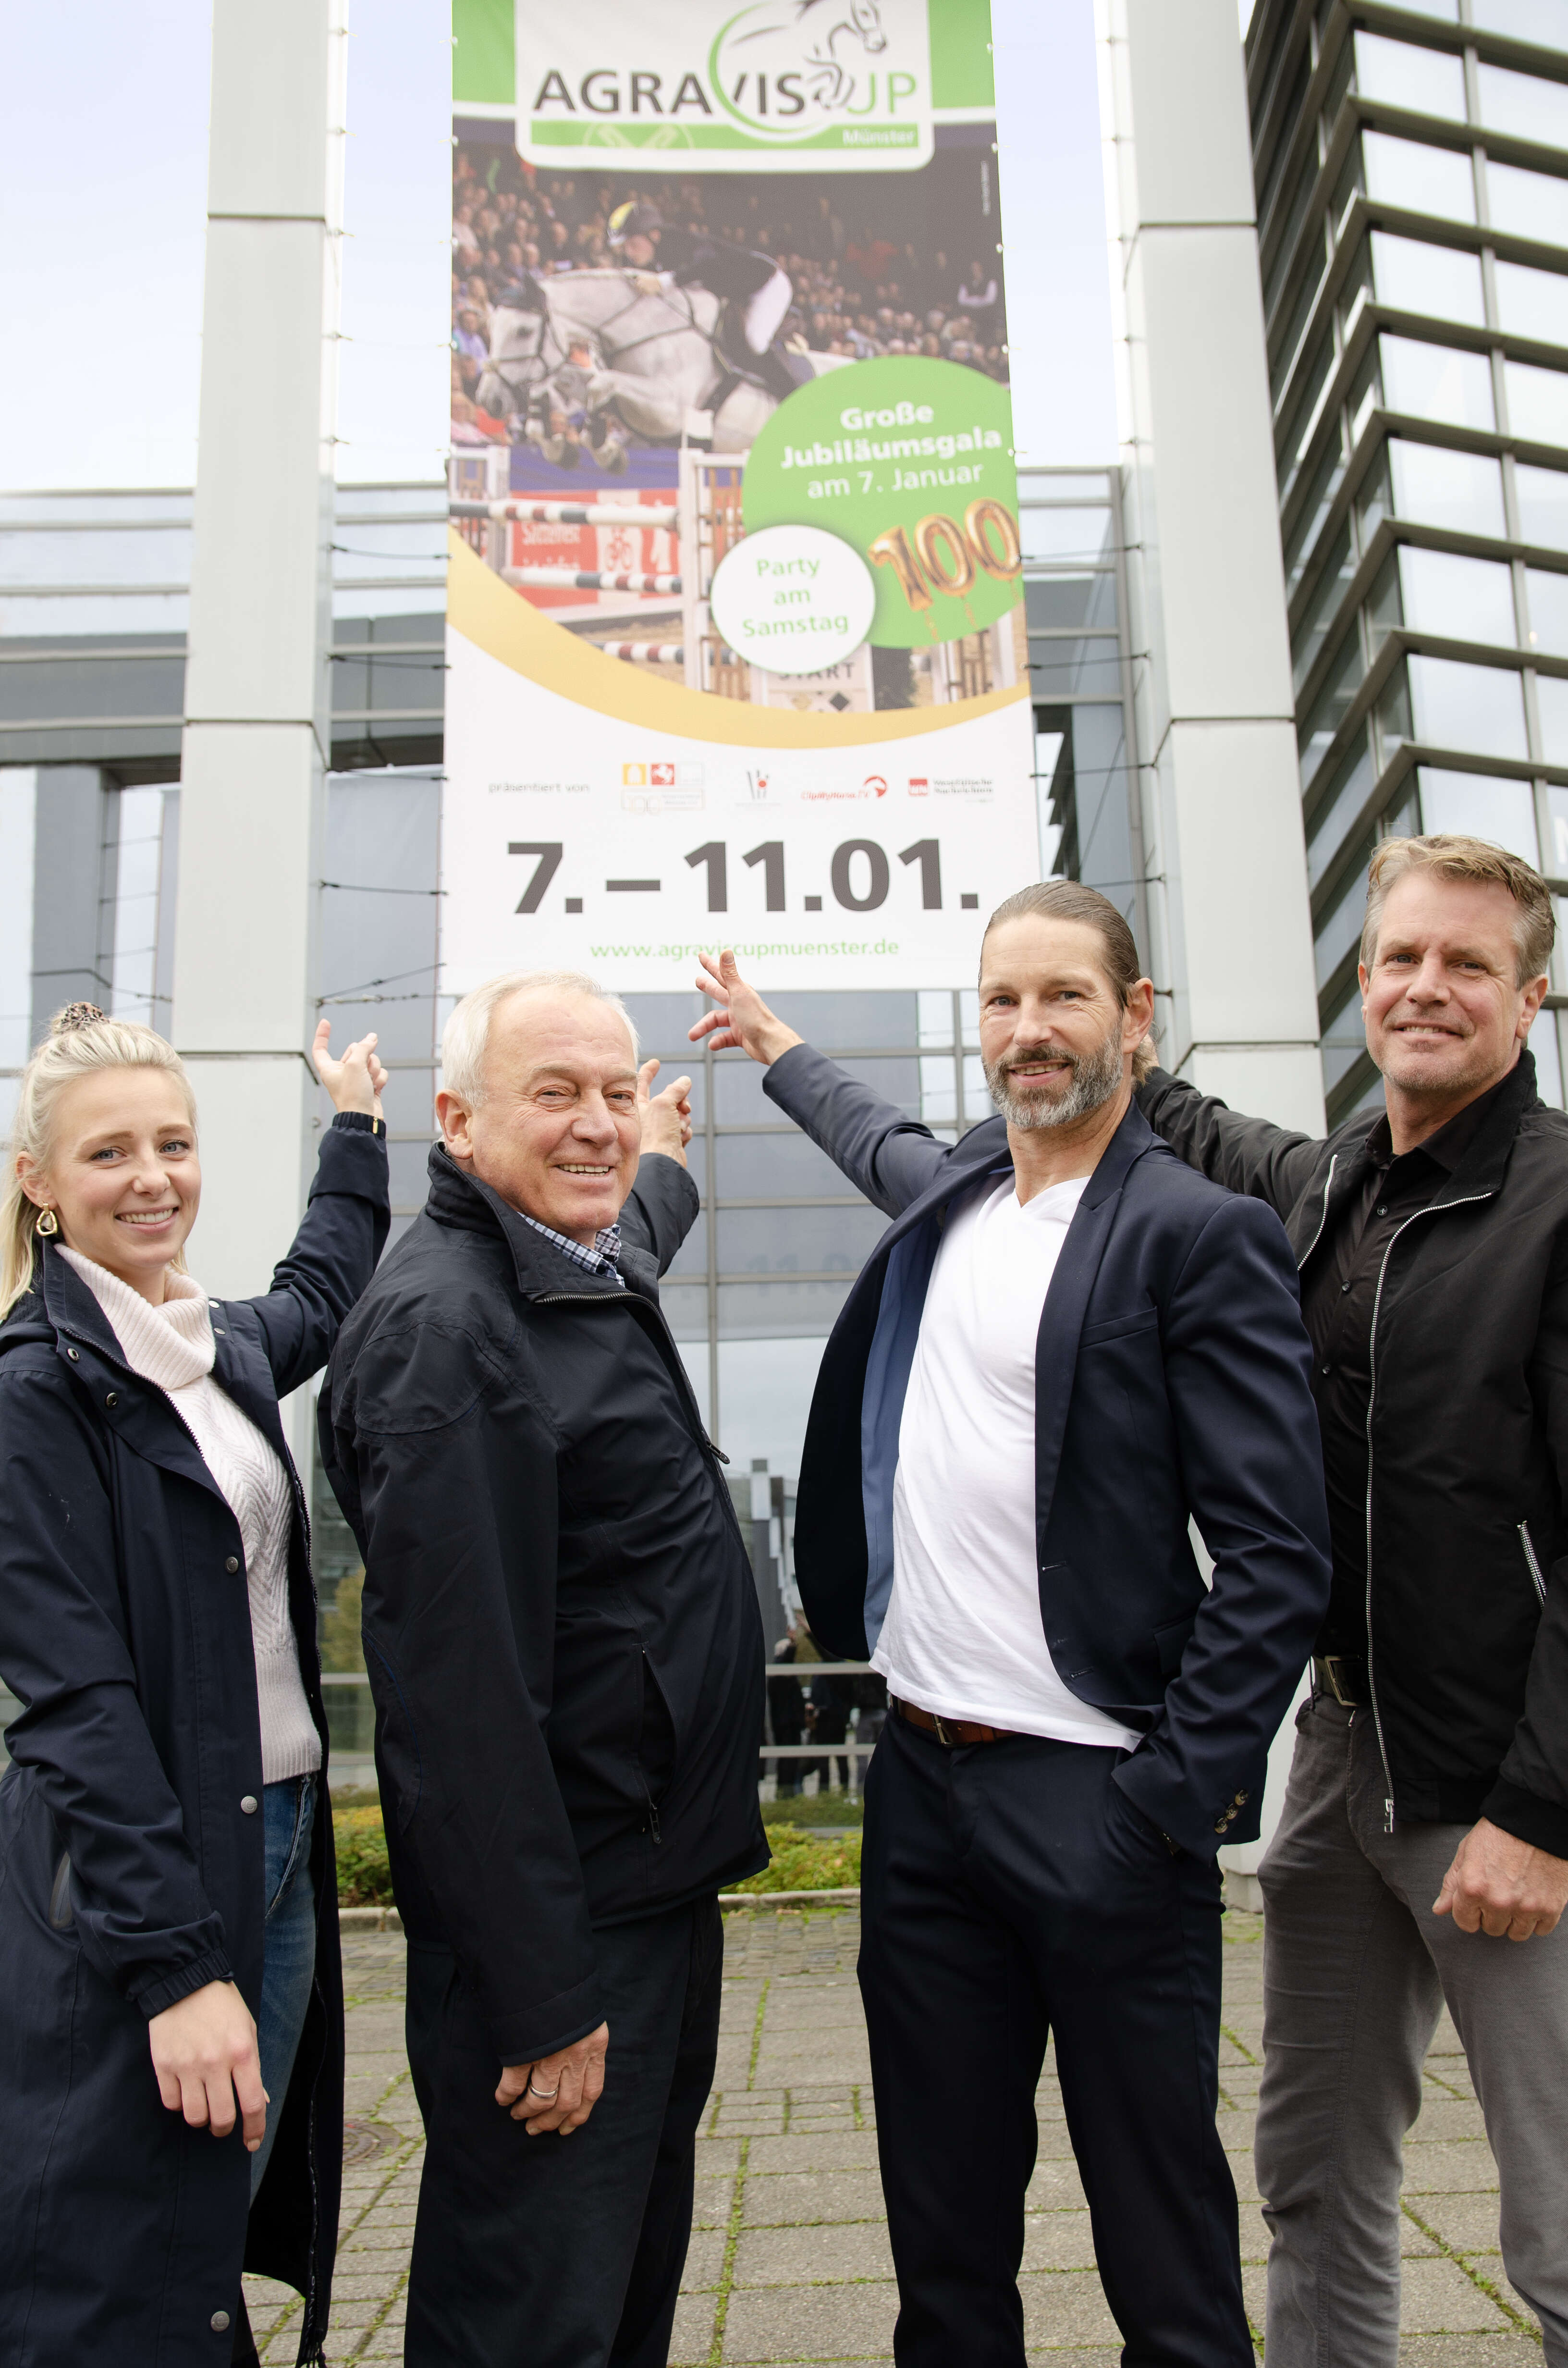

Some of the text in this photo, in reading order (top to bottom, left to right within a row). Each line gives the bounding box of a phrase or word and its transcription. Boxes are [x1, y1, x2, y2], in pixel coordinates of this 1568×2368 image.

[842, 129, 916, 145] Münster
[839, 401, 934, 431] Große
[780, 425, 1003, 469] Jubiläumsgala
[807, 463, 984, 499] am 7. Januar
[867, 497, 1022, 611] 100
[757, 558, 821, 578] Party
[773, 589, 811, 606] am
[743, 615, 850, 639] Samstag
[565, 784, 591, 794] von
[508, 842, 584, 915] 7.
[684, 839, 980, 913] 11.01.
